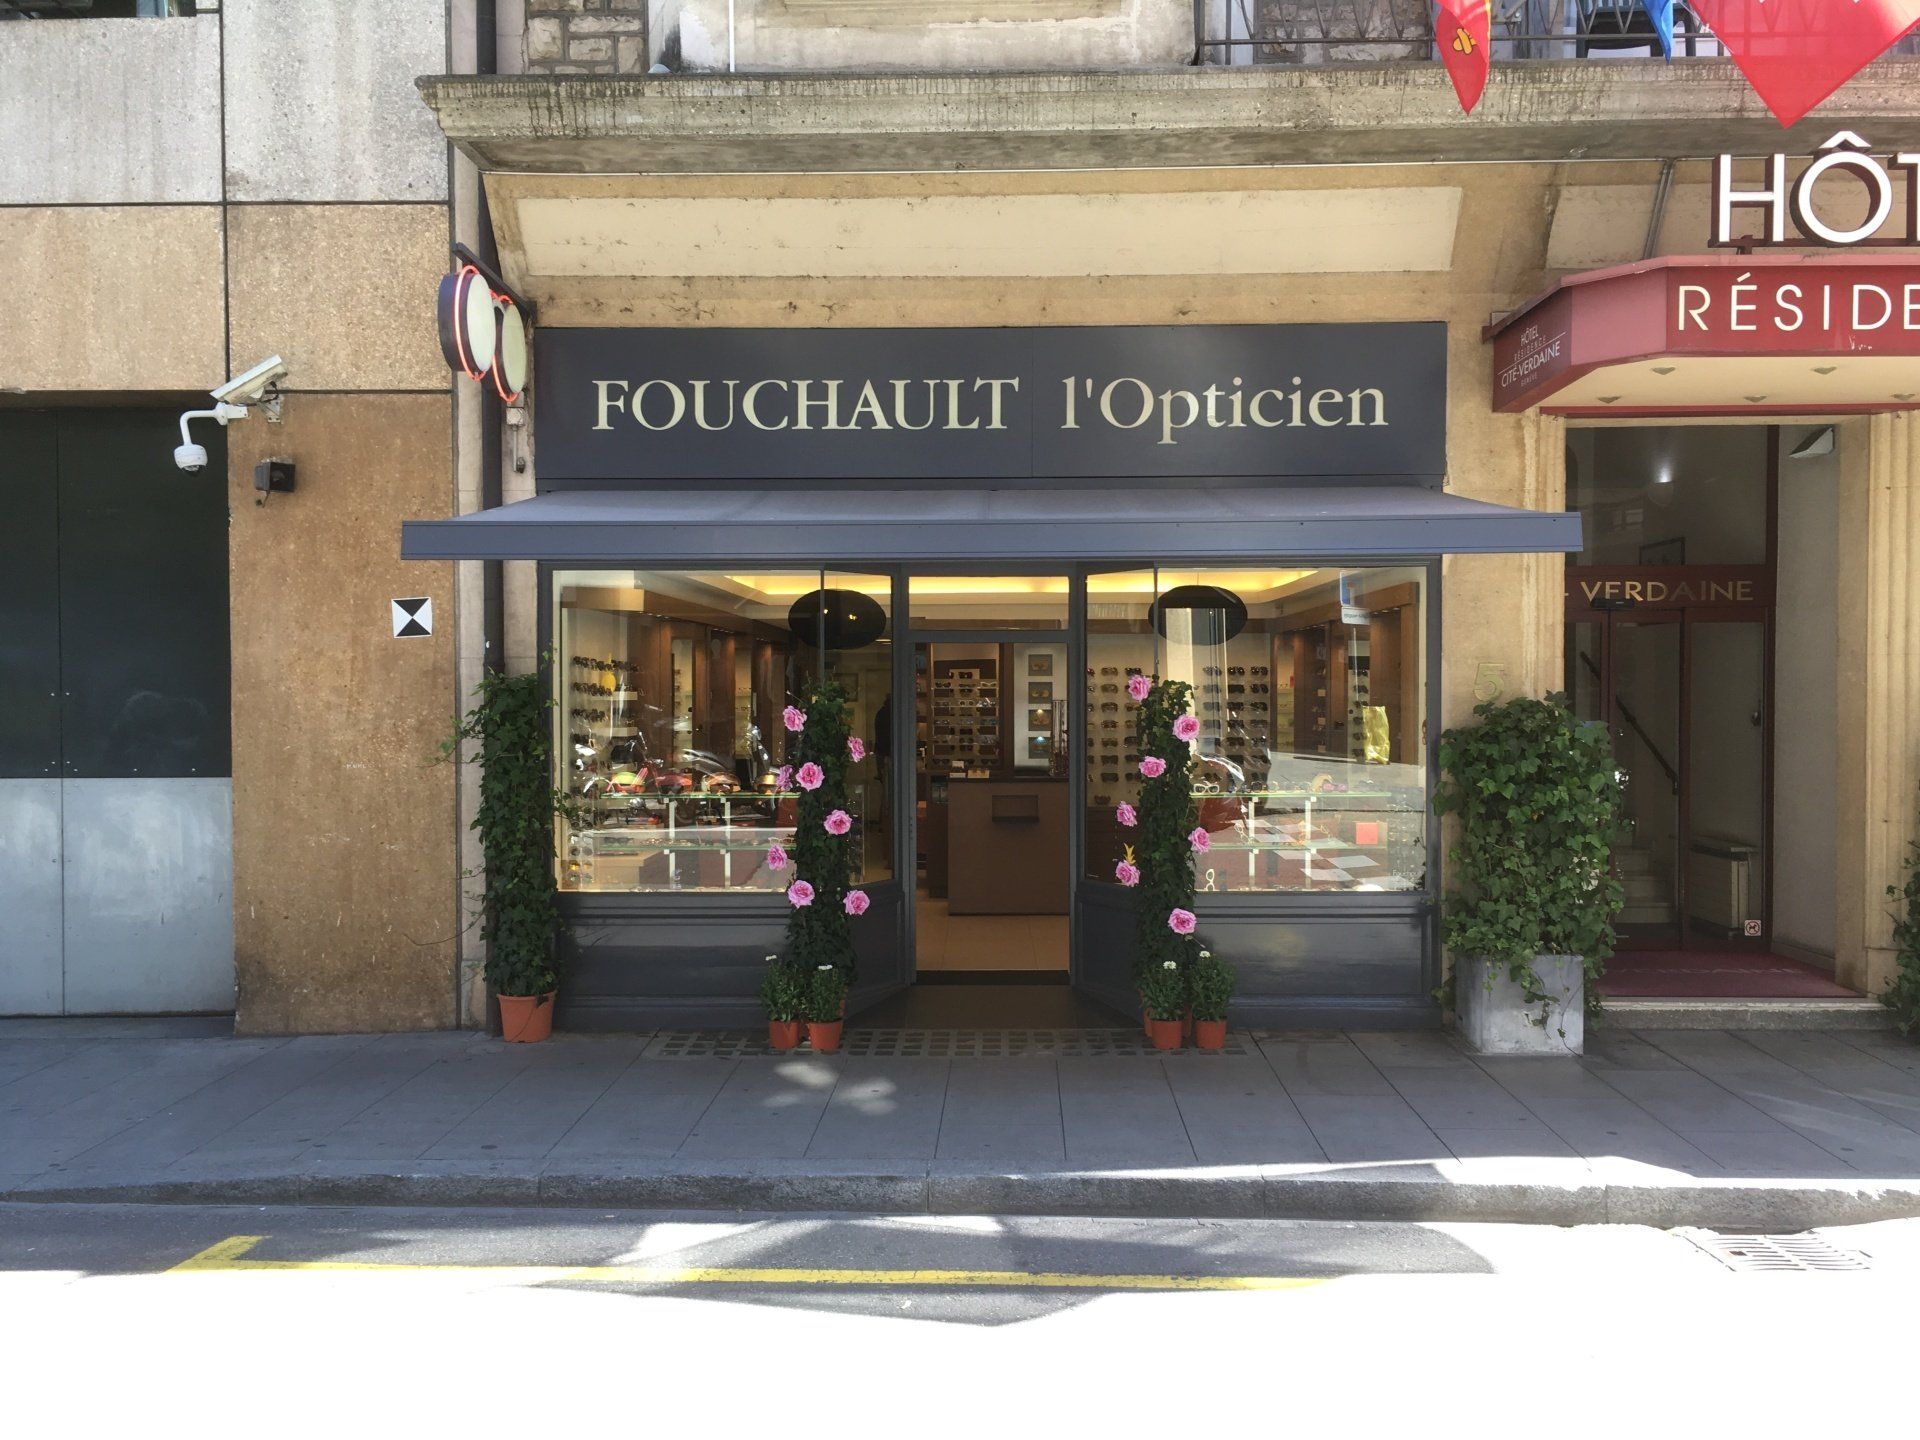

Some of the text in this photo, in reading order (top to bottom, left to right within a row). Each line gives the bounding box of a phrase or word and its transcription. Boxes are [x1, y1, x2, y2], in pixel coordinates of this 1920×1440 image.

[1678, 271, 1920, 331] RÉSIDE
[592, 375, 1390, 446] FOUCHAULT l'Opticien
[1473, 662, 1505, 703] 5
